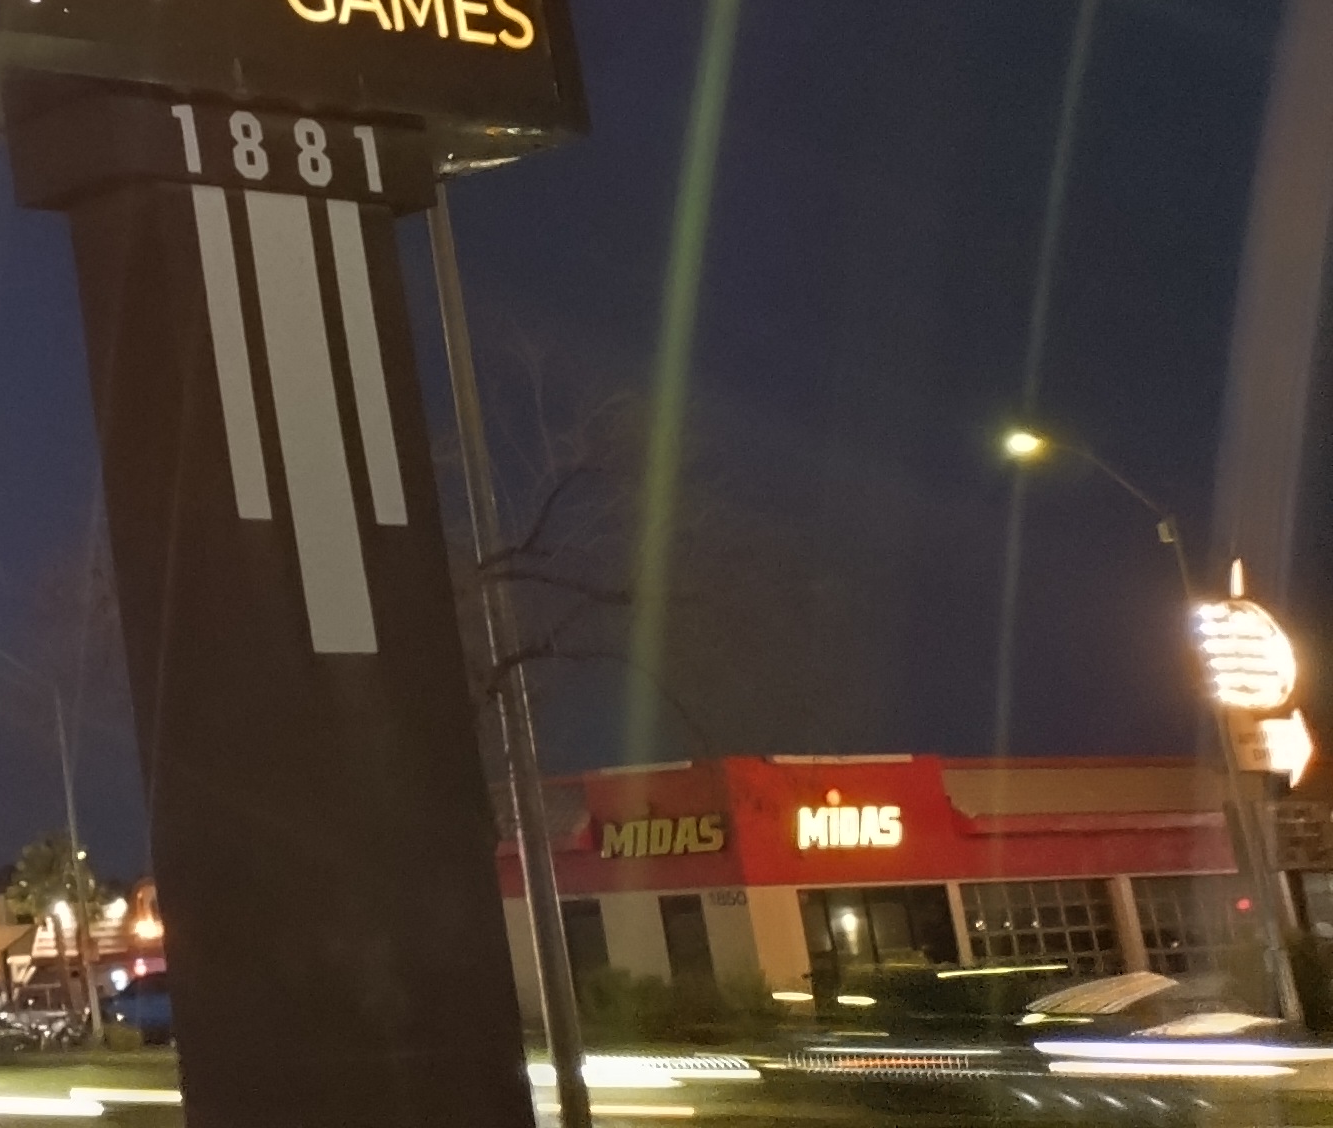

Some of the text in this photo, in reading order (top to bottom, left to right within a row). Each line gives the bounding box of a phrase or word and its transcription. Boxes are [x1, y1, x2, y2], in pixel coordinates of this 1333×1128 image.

[171, 104, 384, 194] 1881
[600, 813, 724, 859] MIDAS
[797, 789, 903, 851] MIDAS
